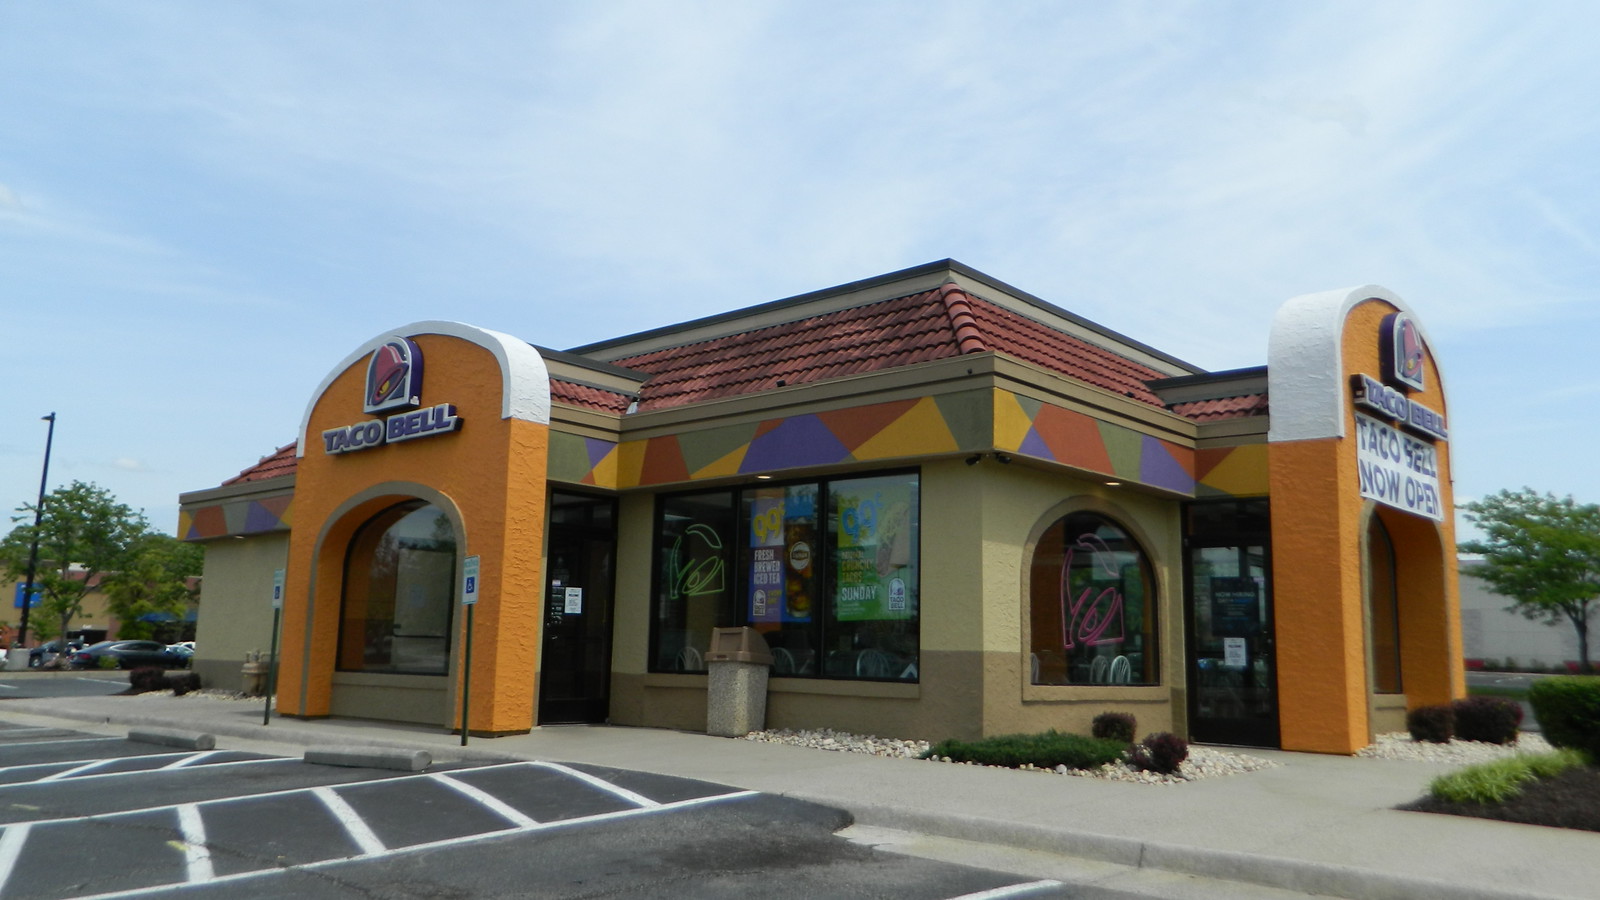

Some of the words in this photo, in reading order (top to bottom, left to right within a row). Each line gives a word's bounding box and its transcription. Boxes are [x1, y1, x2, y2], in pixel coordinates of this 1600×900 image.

[1364, 377, 1408, 420] TACO
[1410, 400, 1448, 438] BELL
[322, 421, 384, 453] TACO
[387, 405, 453, 441] BELL
[1356, 415, 1400, 463] TACO
[1360, 458, 1401, 503] NOW
[1404, 476, 1439, 516] OPEN
[754, 549, 775, 561] FRESH
[754, 560, 781, 573] BREWED
[753, 573, 768, 585] ICED
[769, 572, 781, 584] TEA
[841, 586, 877, 601] SUNDAY
